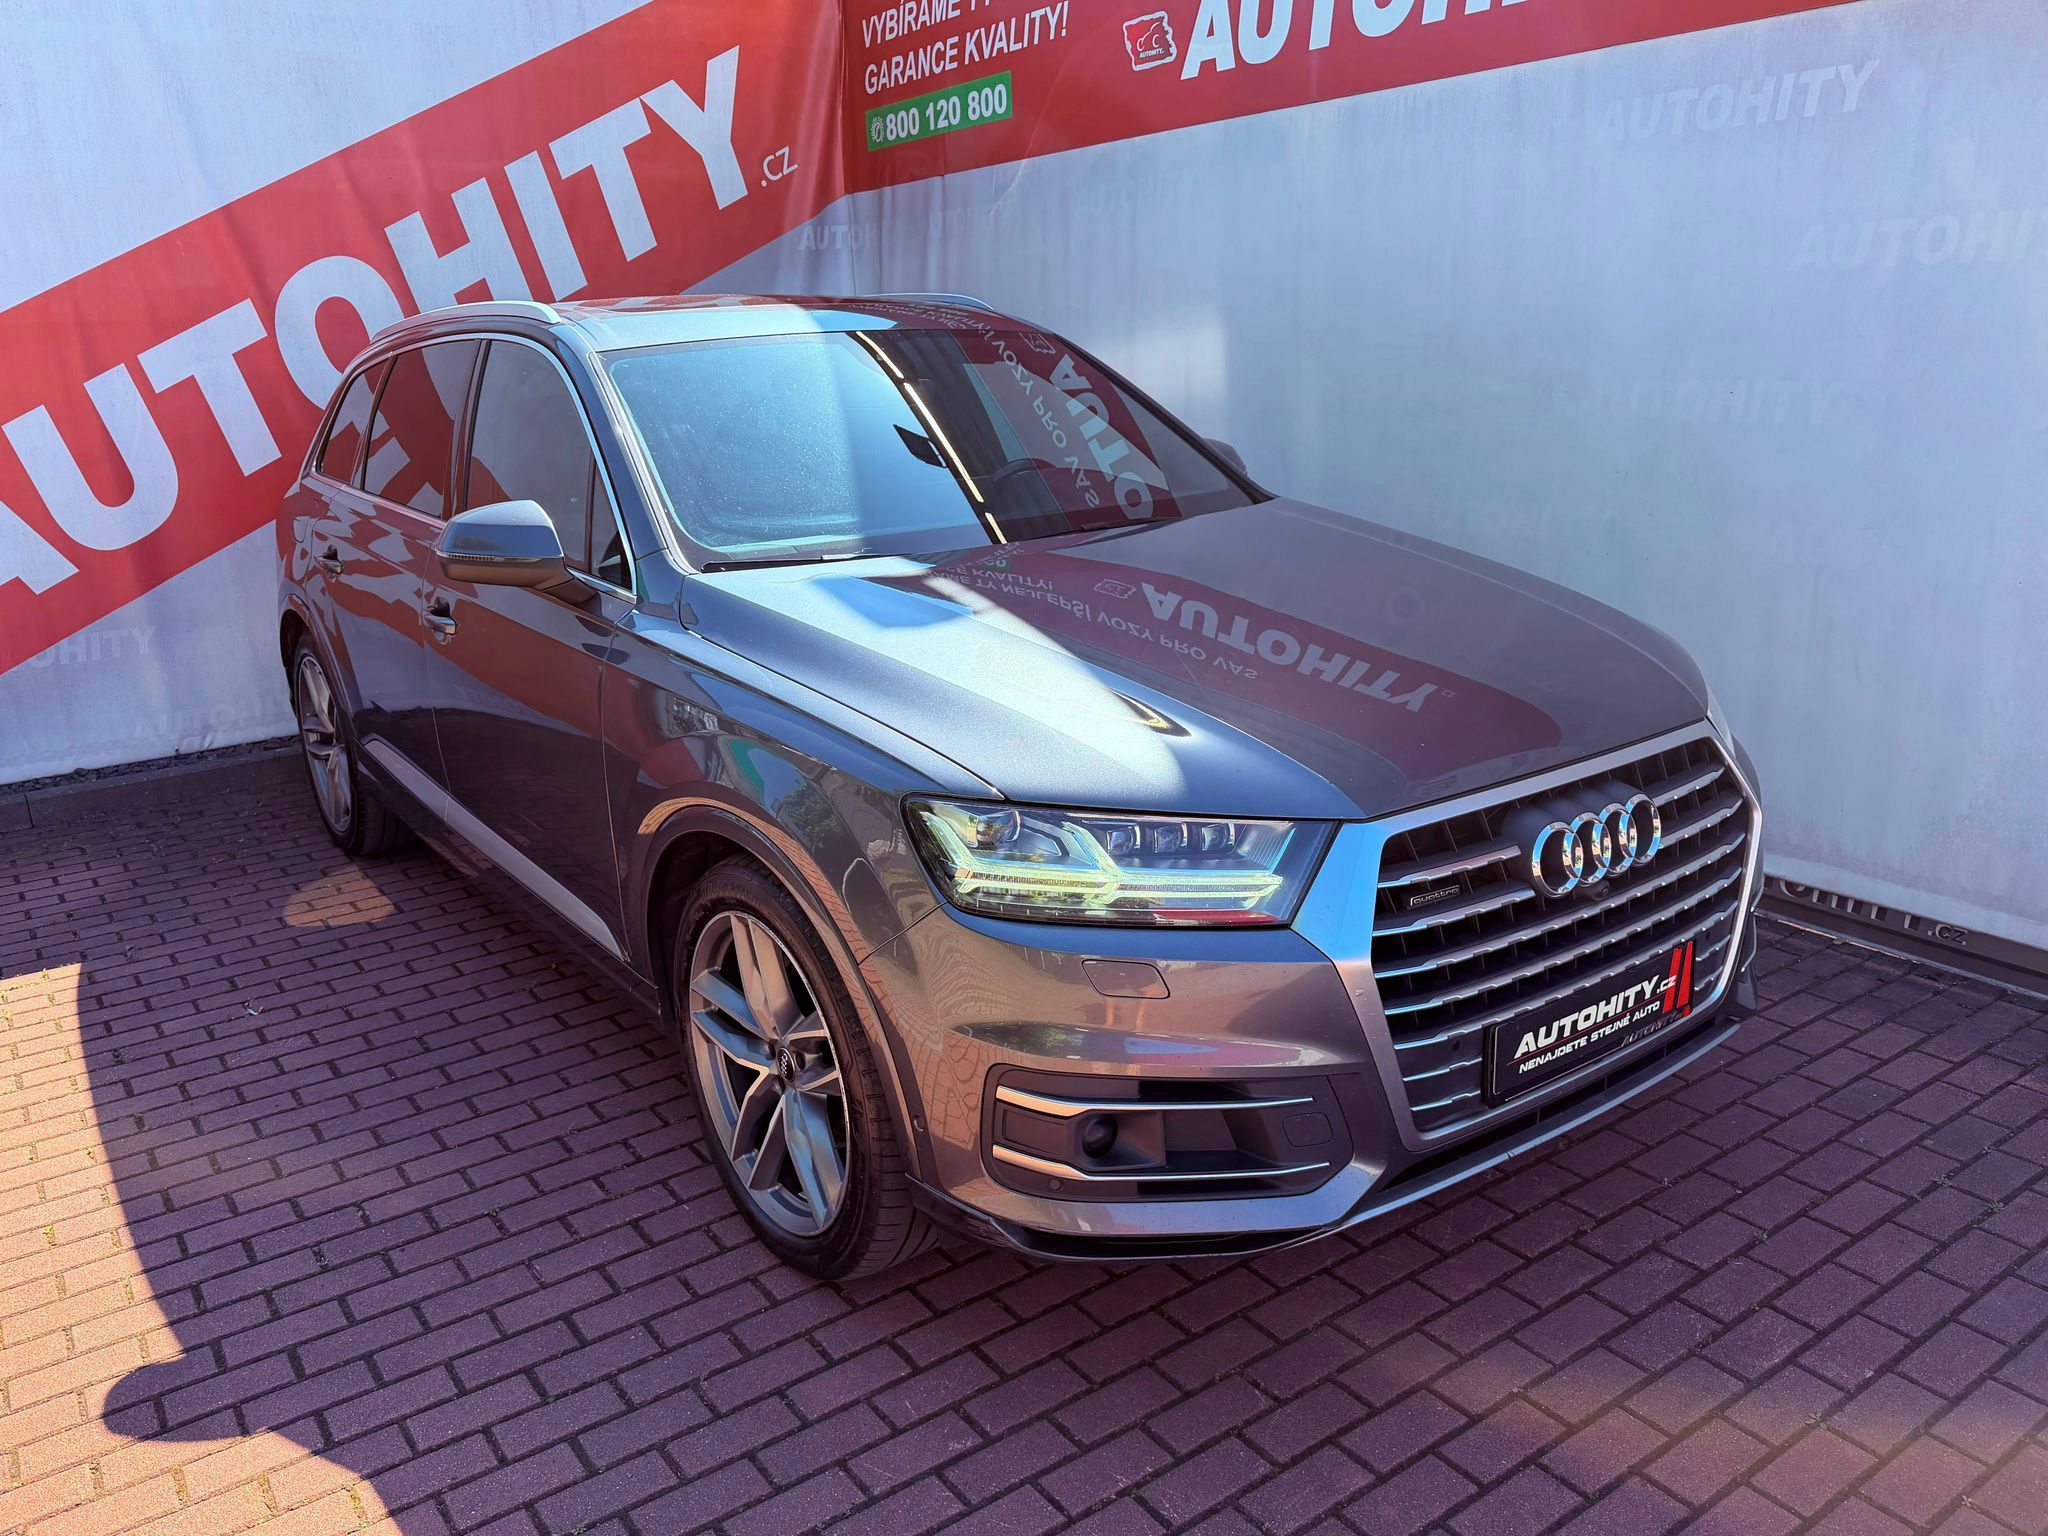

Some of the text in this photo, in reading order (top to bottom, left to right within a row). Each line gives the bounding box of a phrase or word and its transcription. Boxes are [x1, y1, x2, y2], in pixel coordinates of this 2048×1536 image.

[864, 1, 1069, 95] GARANCE KVALITY!
[886, 109, 919, 141] 800
[926, 95, 961, 131] 120
[968, 83, 1007, 121] 800
[1519, 1000, 1660, 1074] NENAJDETE STEJNÉ AUTO
